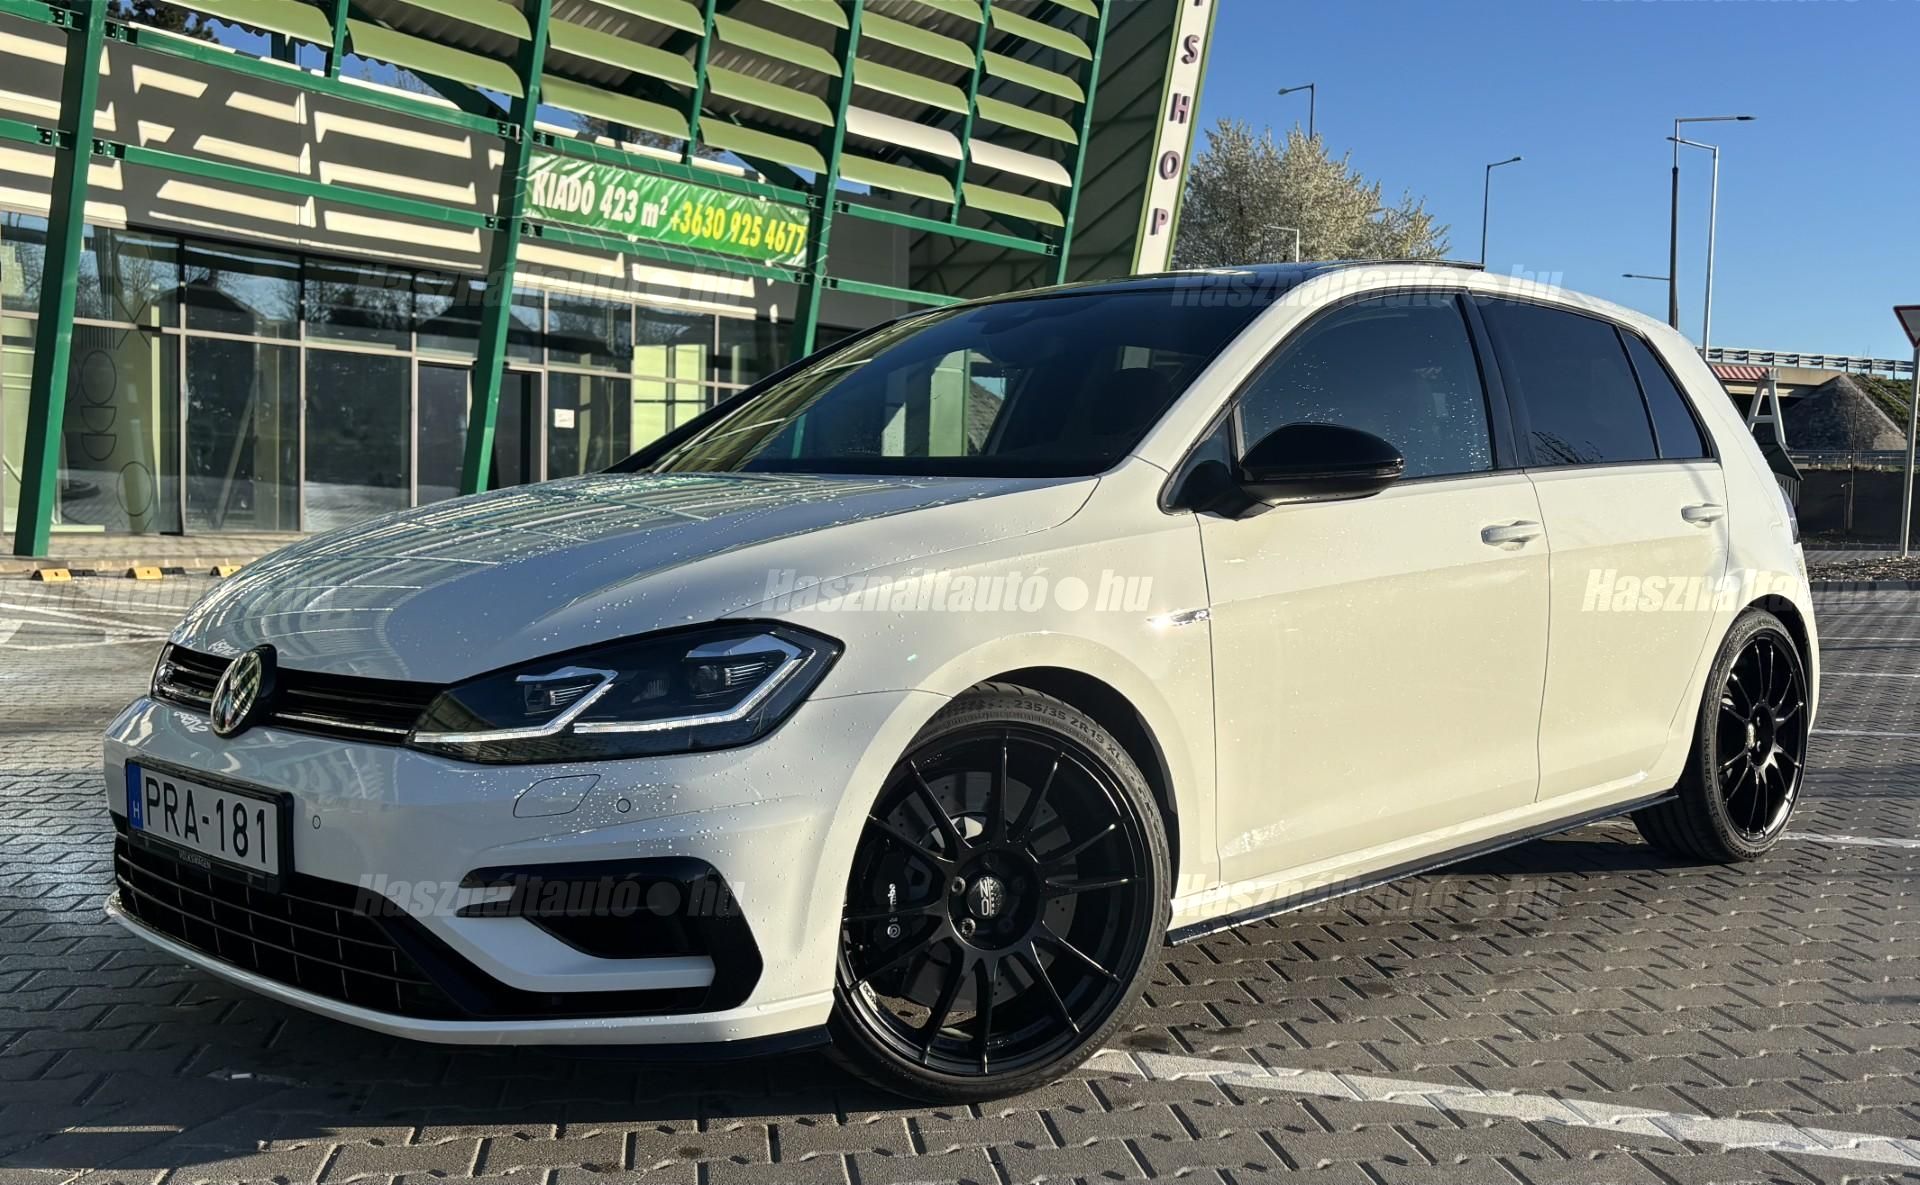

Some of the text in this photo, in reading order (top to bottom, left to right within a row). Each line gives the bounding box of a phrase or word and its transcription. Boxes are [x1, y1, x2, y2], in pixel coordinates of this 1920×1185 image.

[1149, 0, 1201, 236] SHOP
[532, 169, 596, 215] KIADÓ
[599, 184, 637, 224] 423
[670, 201, 724, 239] +3630
[730, 211, 761, 247] 925
[764, 219, 806, 256] 4677
[145, 775, 267, 864] PRA-181
